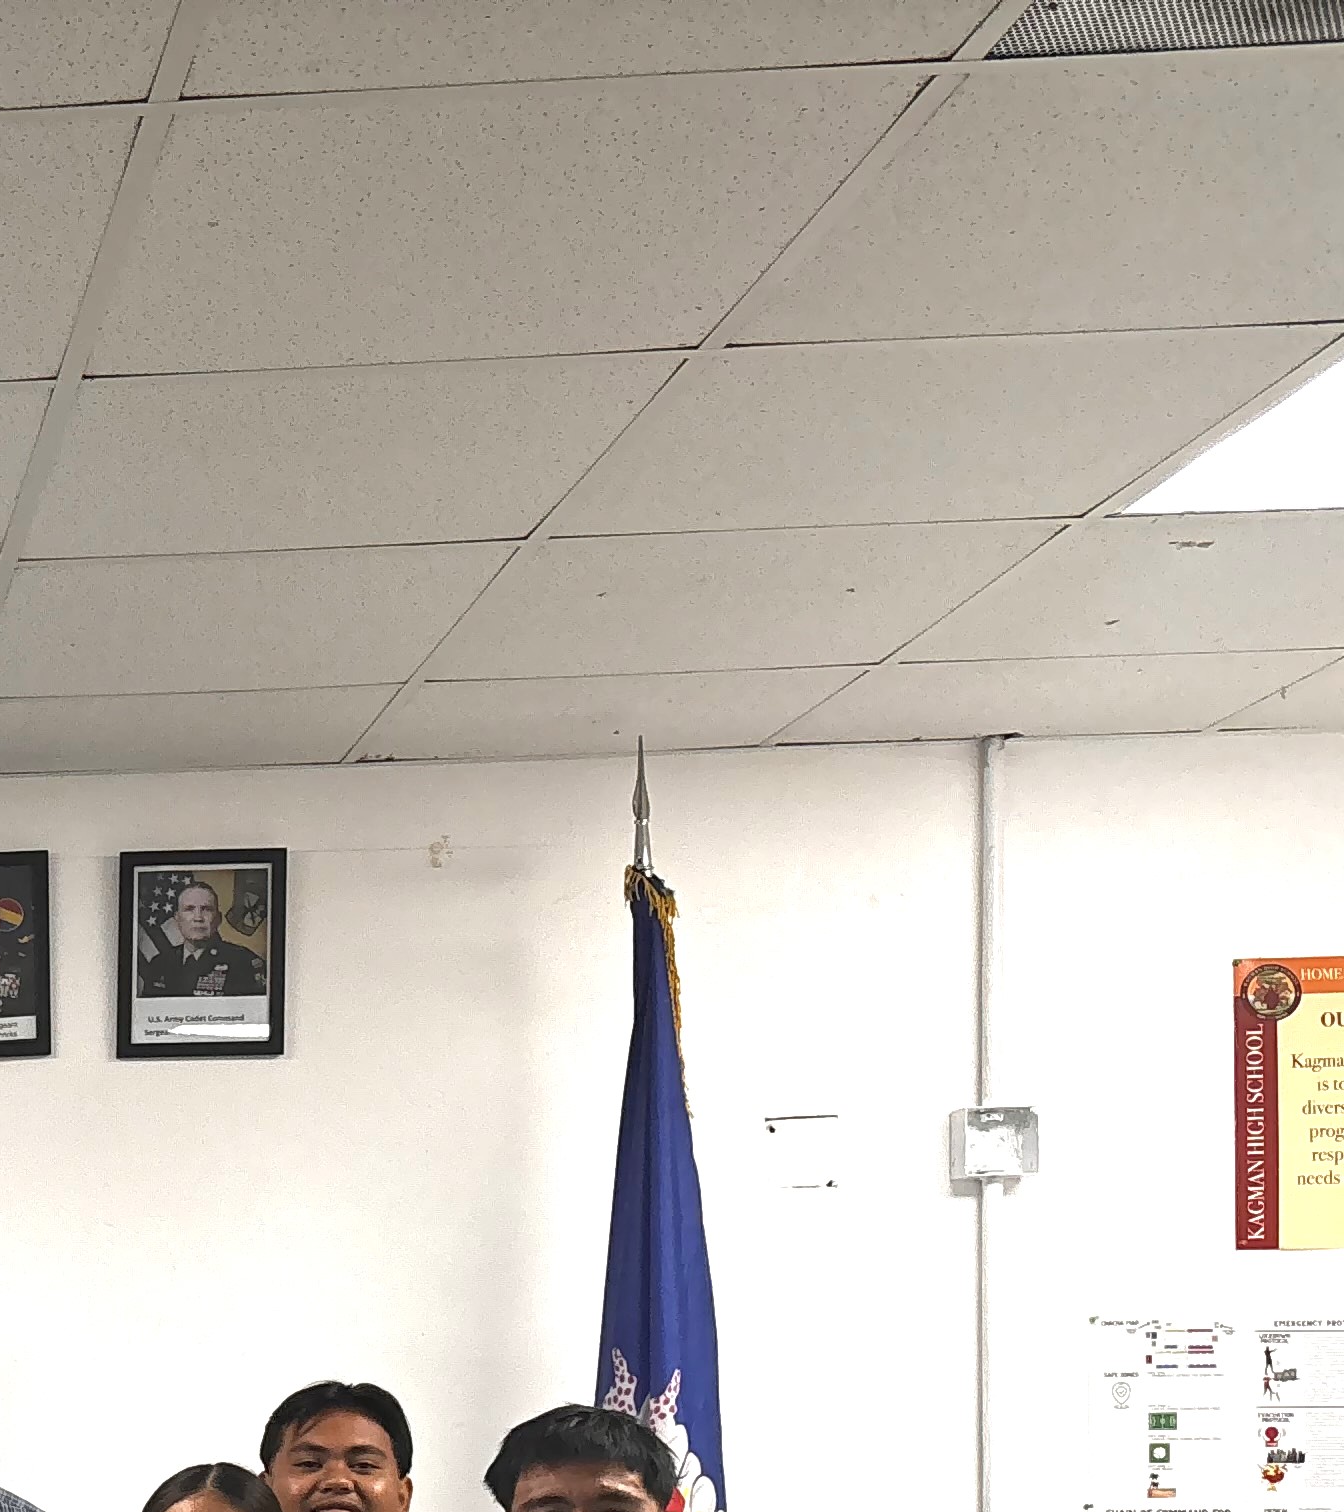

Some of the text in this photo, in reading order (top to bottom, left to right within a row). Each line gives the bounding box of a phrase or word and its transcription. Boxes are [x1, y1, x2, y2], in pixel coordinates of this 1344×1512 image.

[1245, 1023, 1265, 1240] KAGMAN HIGH SCHOOL
[1297, 1169, 1340, 1185] needs
